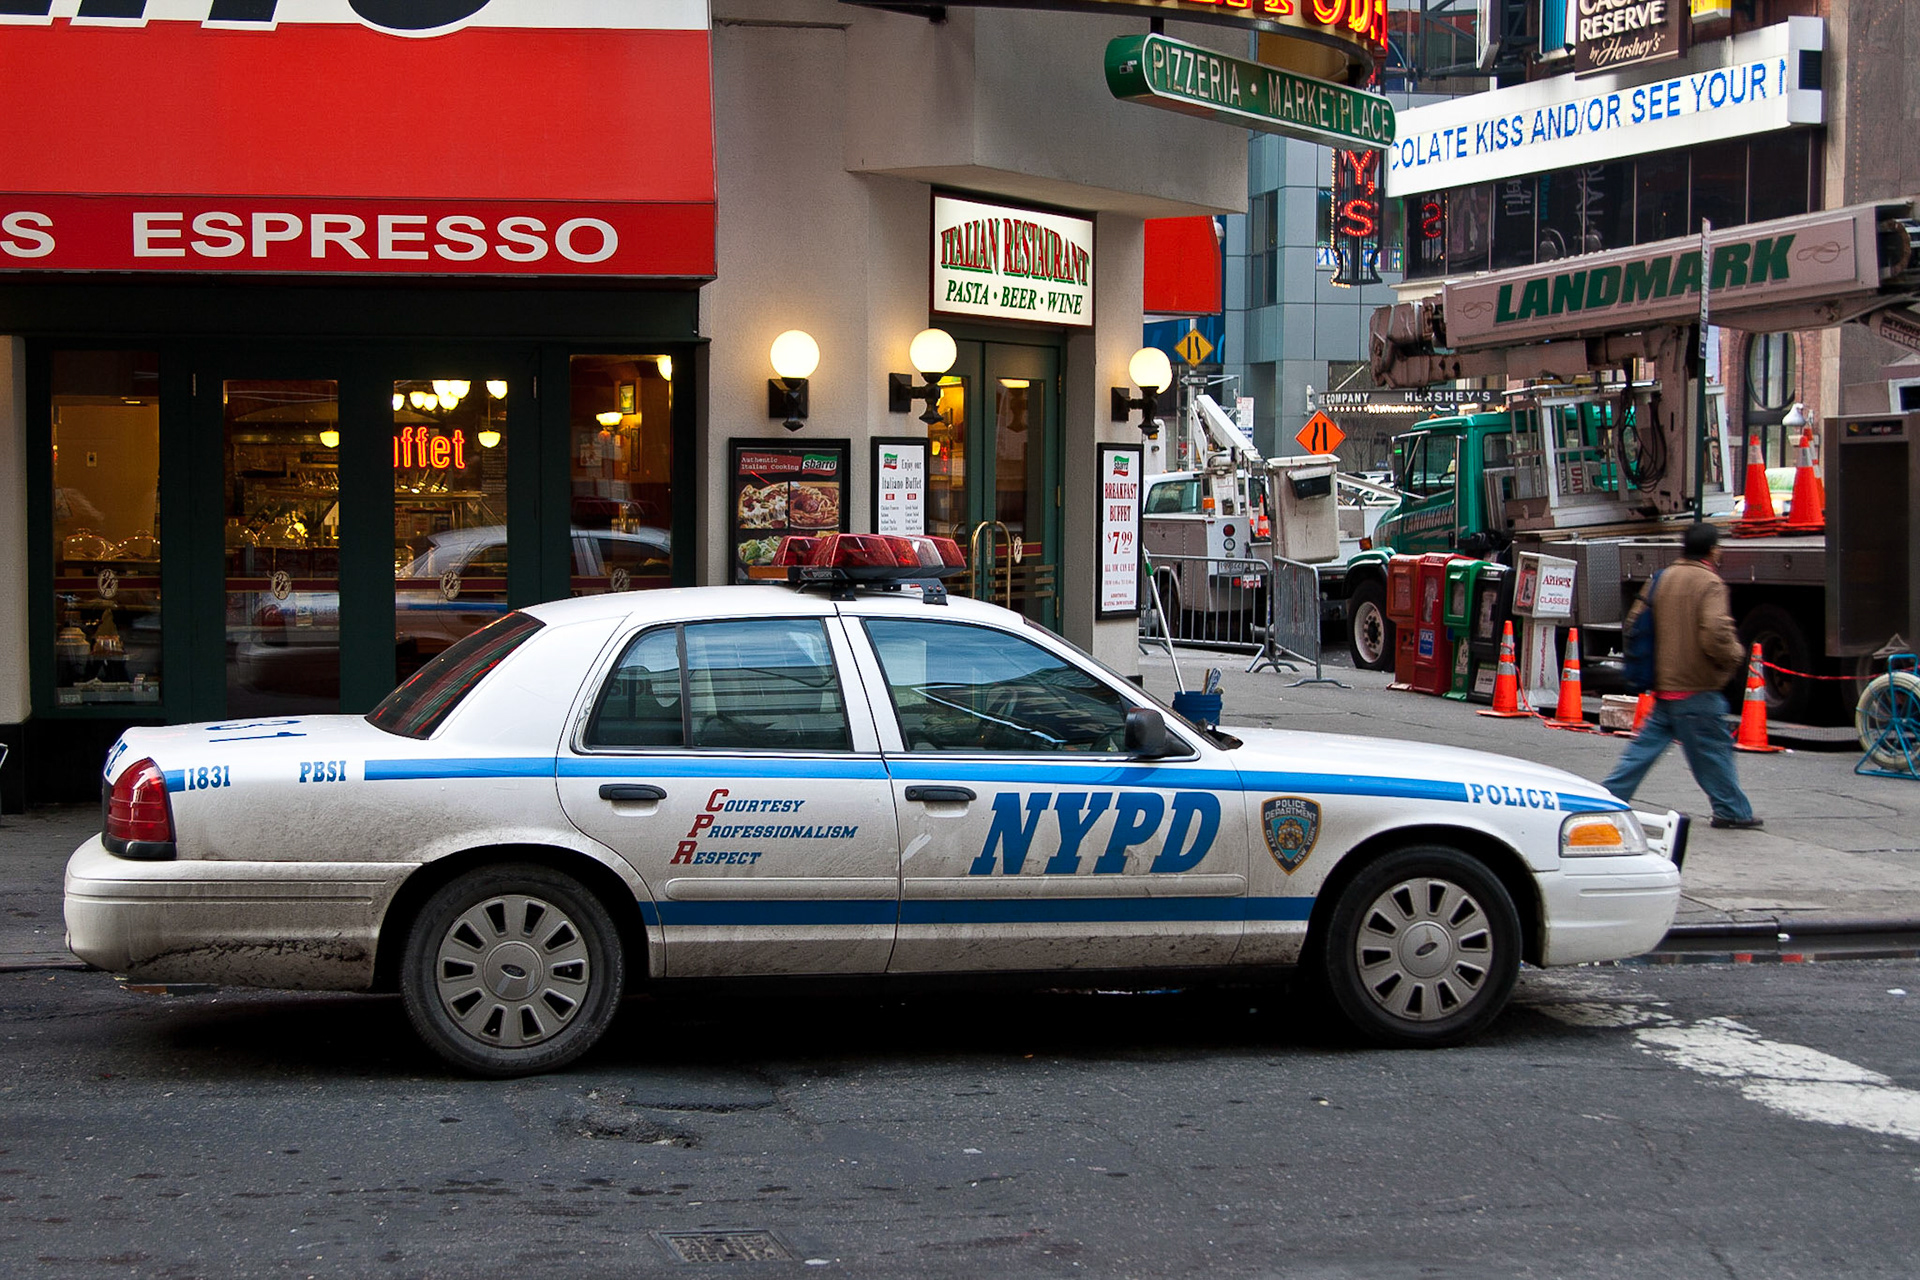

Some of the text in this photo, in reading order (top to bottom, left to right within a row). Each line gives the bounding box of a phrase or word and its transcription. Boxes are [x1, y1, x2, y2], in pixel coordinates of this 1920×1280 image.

[1579, 1, 1666, 42] RESERVE
[1589, 46, 1599, 60] by
[1151, 42, 1392, 142] PIZZERIA MARKETPLACE
[1476, 115, 1524, 155] KISS
[1531, 94, 1620, 145] AND/OR
[1632, 81, 1681, 124] SEE
[1690, 63, 1767, 112] YOUR
[132, 212, 619, 263] ESPRESSO
[940, 218, 1090, 286] ITALIAN RESTAURANT
[1495, 234, 1796, 324] LANDMARK
[946, 279, 1083, 315] PASTA BEER WINE
[1326, 393, 1369, 404] COMPANY
[1404, 391, 1491, 403] HERSHEY'S
[770, 463, 800, 471] Cooking
[803, 458, 836, 470] sbarro
[881, 477, 922, 490] Italiano Buffet
[1105, 483, 1137, 499] BREAKFAST
[1110, 505, 1131, 522] BUFFET
[1540, 596, 1570, 606] CLASSES
[188, 765, 231, 790] 1831
[299, 760, 346, 783] PBSI
[1275, 799, 1307, 809] POLICE
[1469, 783, 1556, 811] POLICE
[1265, 807, 1317, 821] DEPARTMENT
[968, 791, 1222, 875] NYPD
